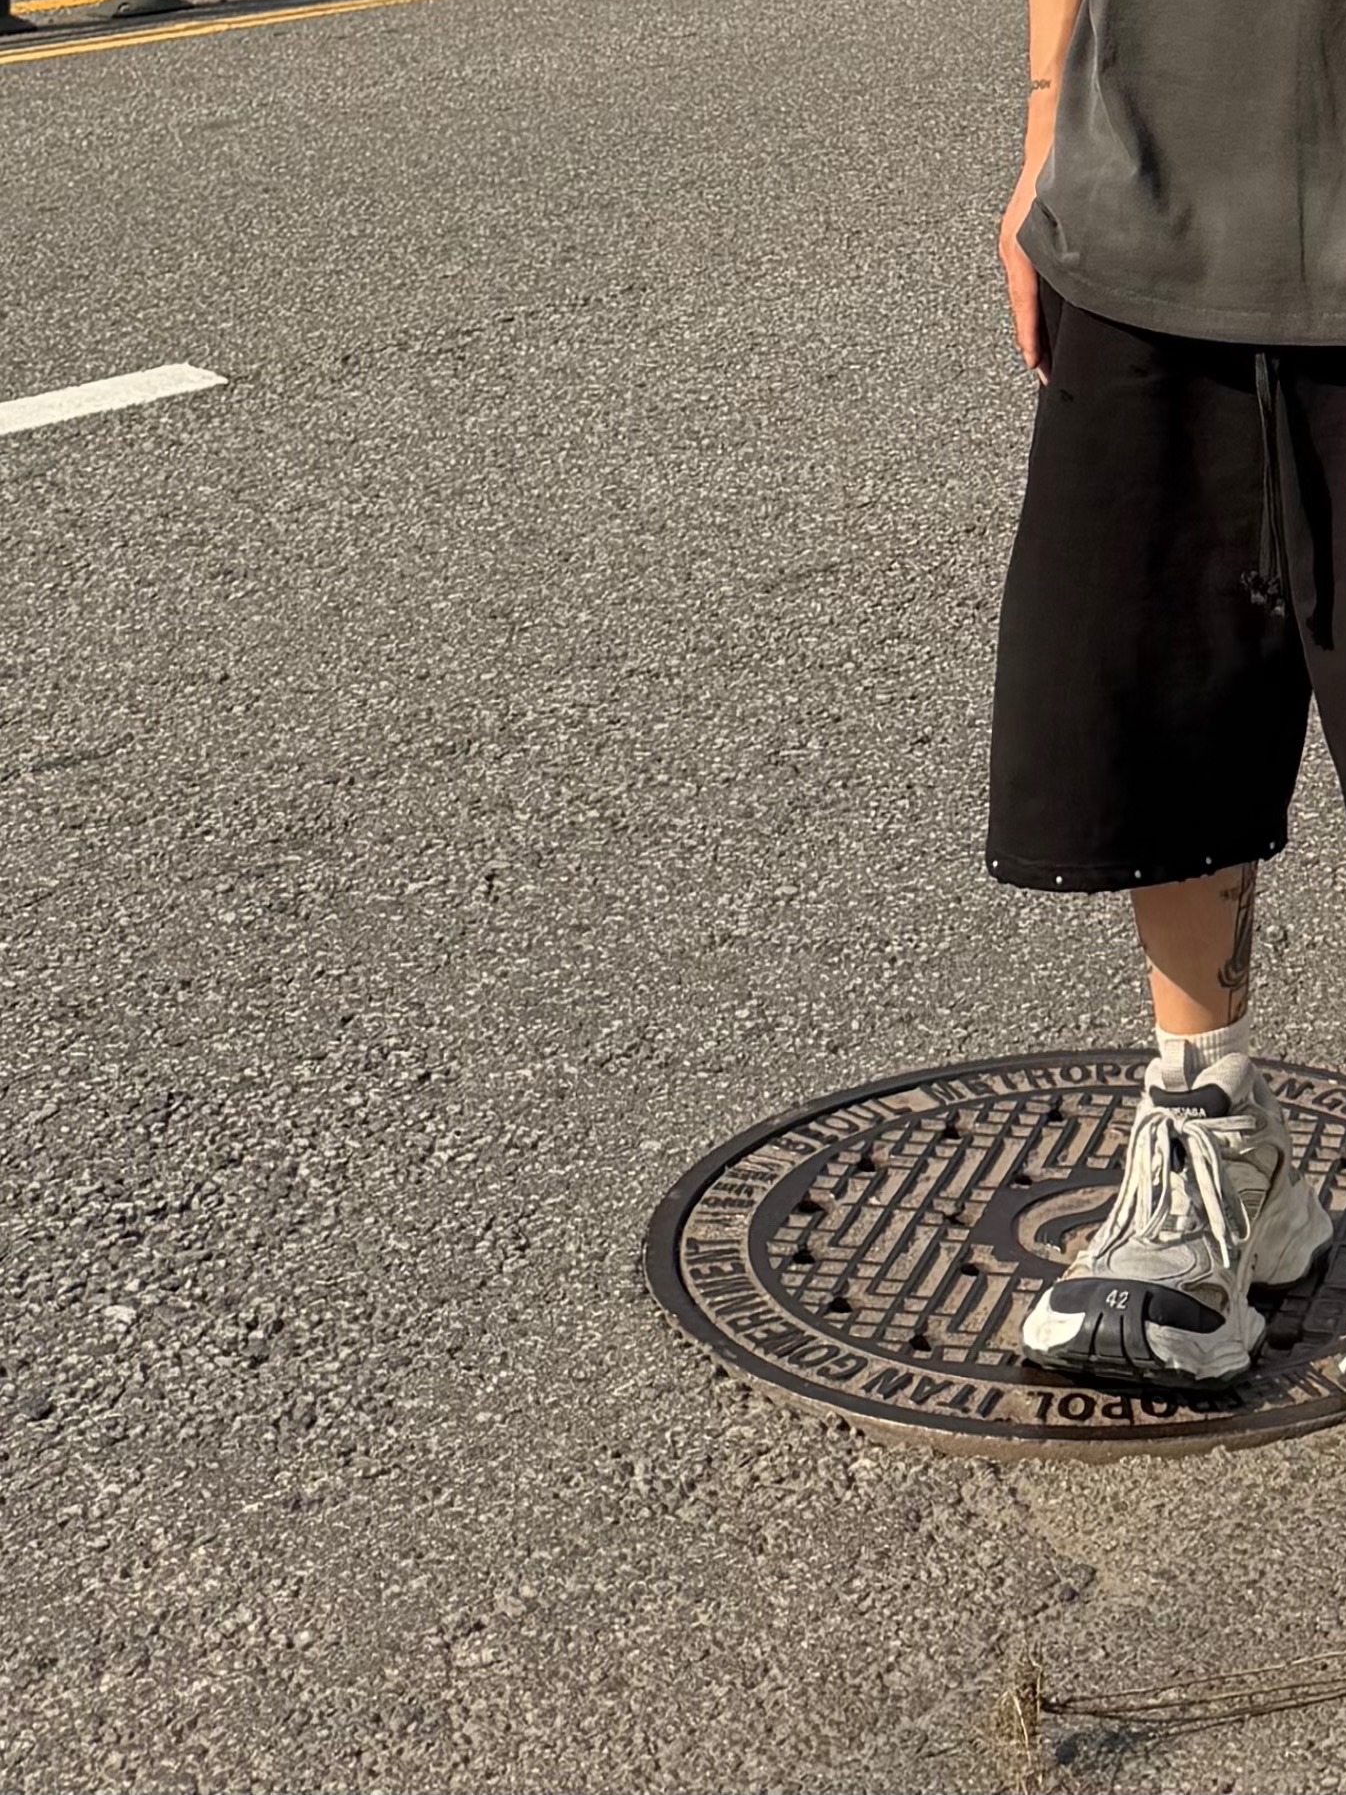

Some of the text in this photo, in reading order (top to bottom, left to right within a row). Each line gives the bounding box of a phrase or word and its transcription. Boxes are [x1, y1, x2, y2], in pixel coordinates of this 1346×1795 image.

[775, 1096, 914, 1155] SEOUL
[686, 1236, 869, 1380] GOVERNMENT
[1105, 1290, 1130, 1310] 42
